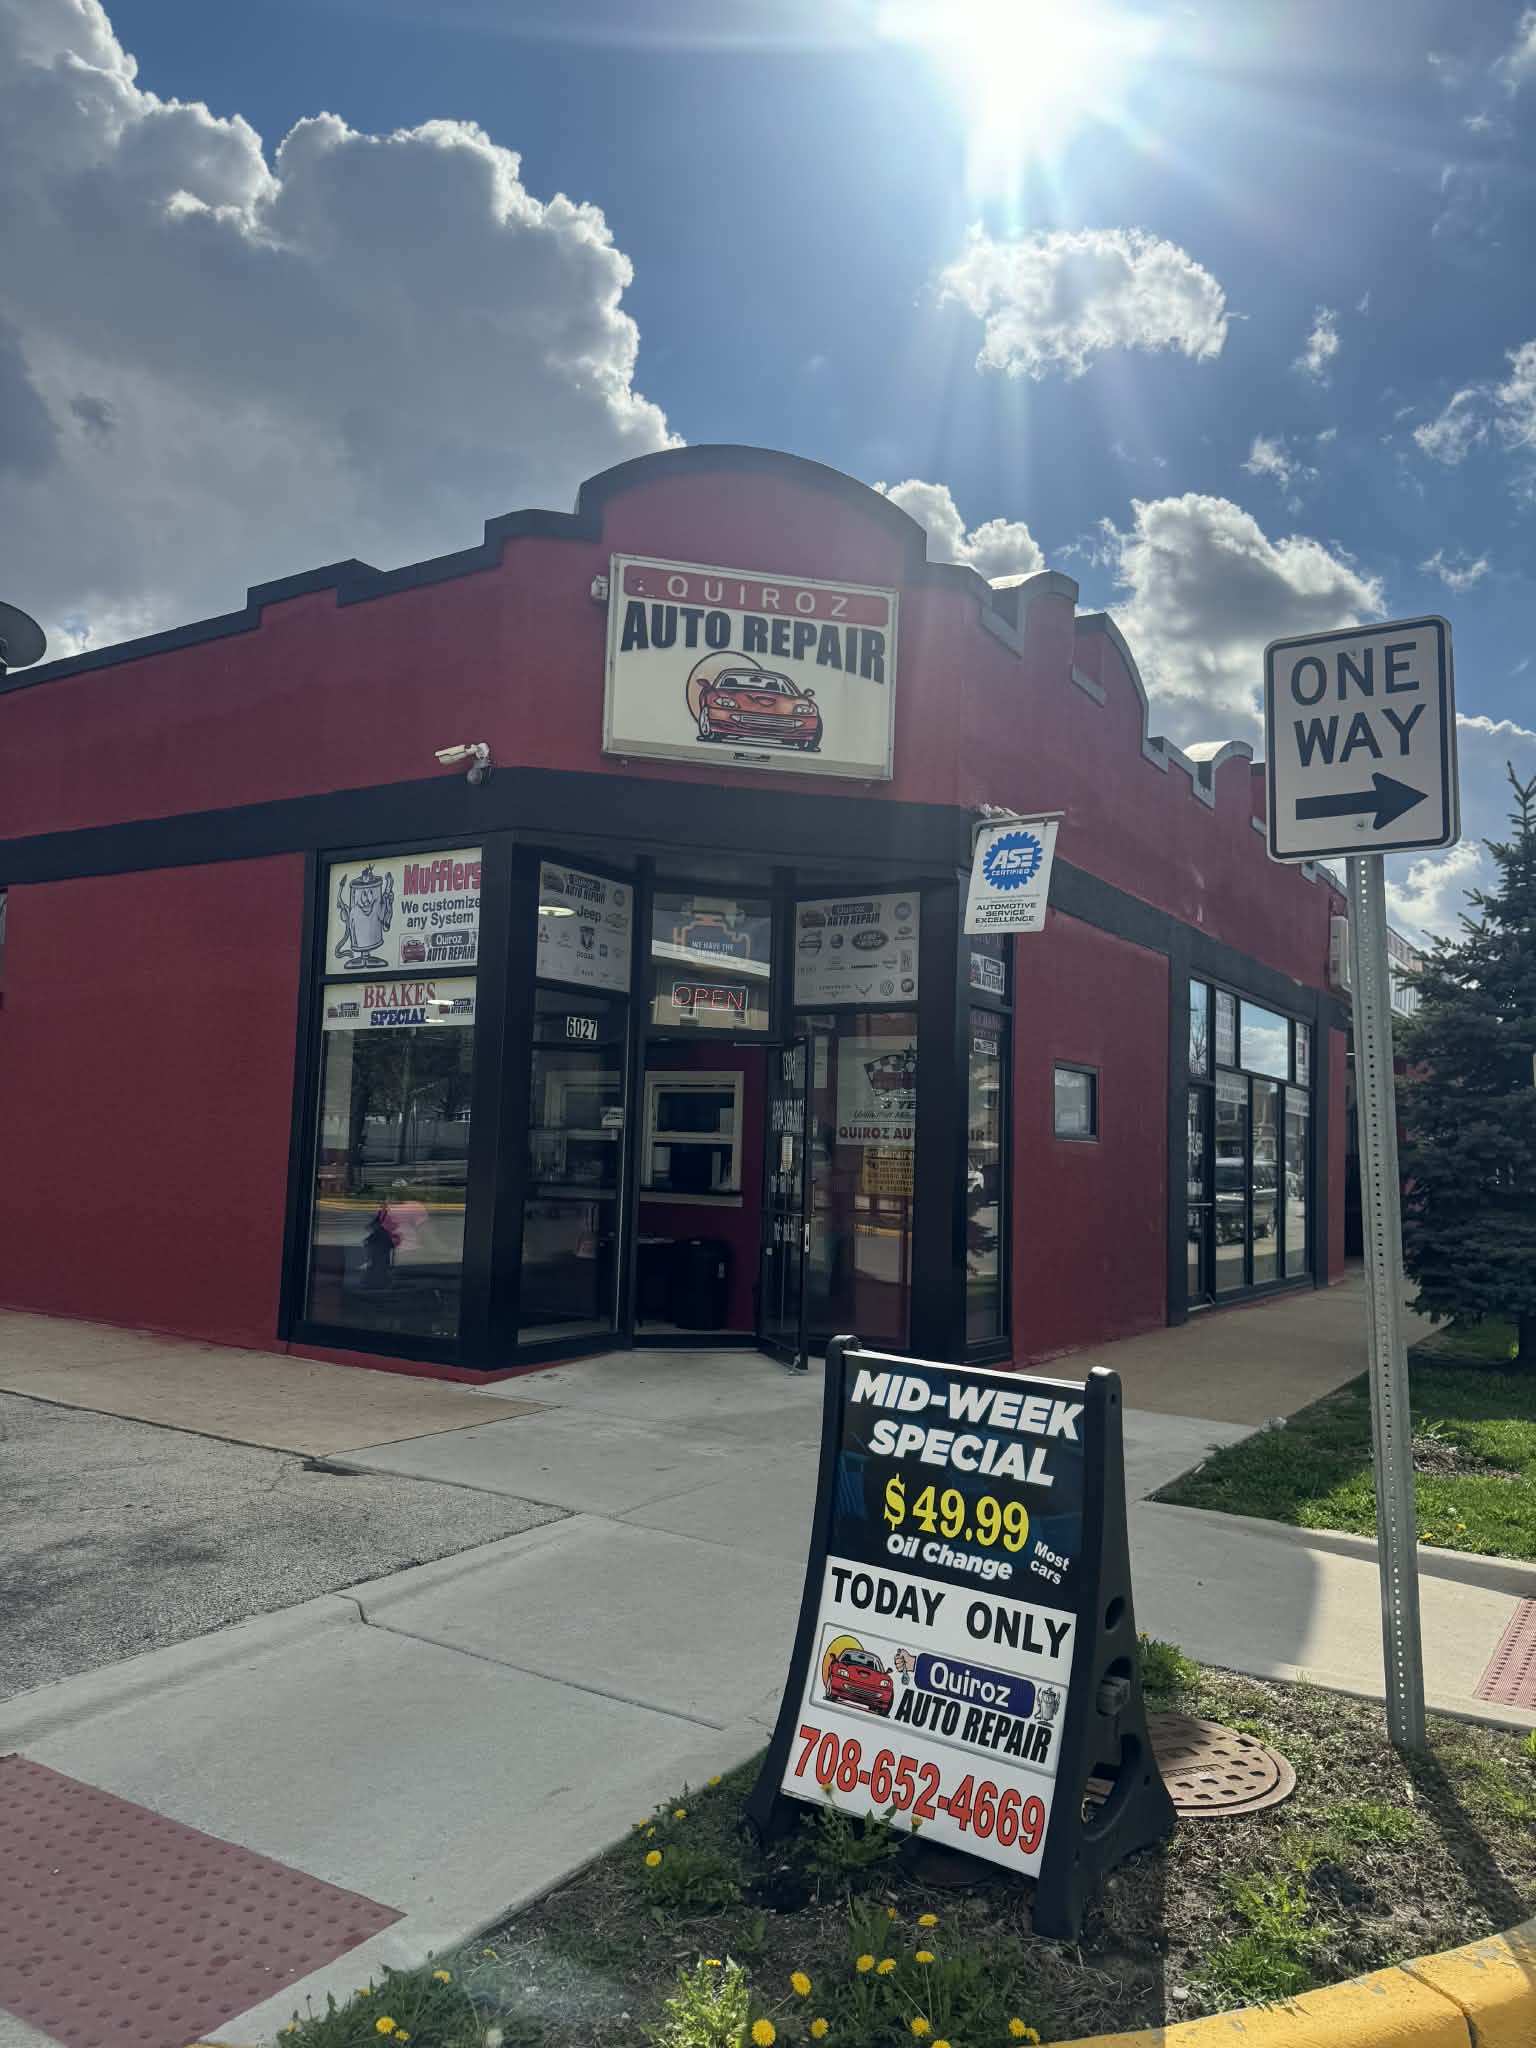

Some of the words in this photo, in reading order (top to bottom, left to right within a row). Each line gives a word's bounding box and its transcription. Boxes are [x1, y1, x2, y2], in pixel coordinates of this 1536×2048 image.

[667, 575, 849, 617] QUIROZ
[620, 600, 731, 651] AUTO
[743, 614, 886, 685] REPAIR
[1291, 641, 1420, 706] ONE
[1293, 703, 1427, 767] WAY
[989, 847, 1035, 869] ASE
[402, 858, 482, 896] Mufflers
[991, 868, 1030, 877] CERTIFIED
[401, 900, 419, 914] We
[422, 895, 481, 913] customize
[576, 904, 601, 924] Jeep
[976, 902, 1037, 912] AUTOMOTIVE
[985, 909, 1026, 918] SERVICE
[406, 916, 428, 930] any
[430, 911, 474, 929] System
[975, 915, 1035, 925] EXCELLENCE
[435, 935, 463, 945] Quiroz
[426, 947, 448, 962] AUTO
[449, 945, 476, 961] REPAIR
[363, 982, 437, 1008] BRAKES
[673, 986, 744, 1010] OPEN
[370, 1008, 427, 1026] SPECIAL
[567, 1017, 598, 1040] 6027
[839, 1126, 892, 1140] QUIROZ
[850, 1369, 1085, 1440] MID-WEEK
[868, 1419, 1056, 1487] SPECIAL
[886, 1533, 917, 1558] Oil
[922, 1537, 1013, 1581] Change
[1034, 1540, 1070, 1573] Most
[1030, 1558, 1063, 1586] cars
[830, 1566, 946, 1627] TODAY
[966, 1601, 1071, 1659] ONLY
[929, 1662, 1011, 1708] Quiroz
[895, 1688, 962, 1737] AUTO
[961, 1701, 1052, 1765] REPAIR
[794, 1724, 1046, 1855] 708-652-4669
